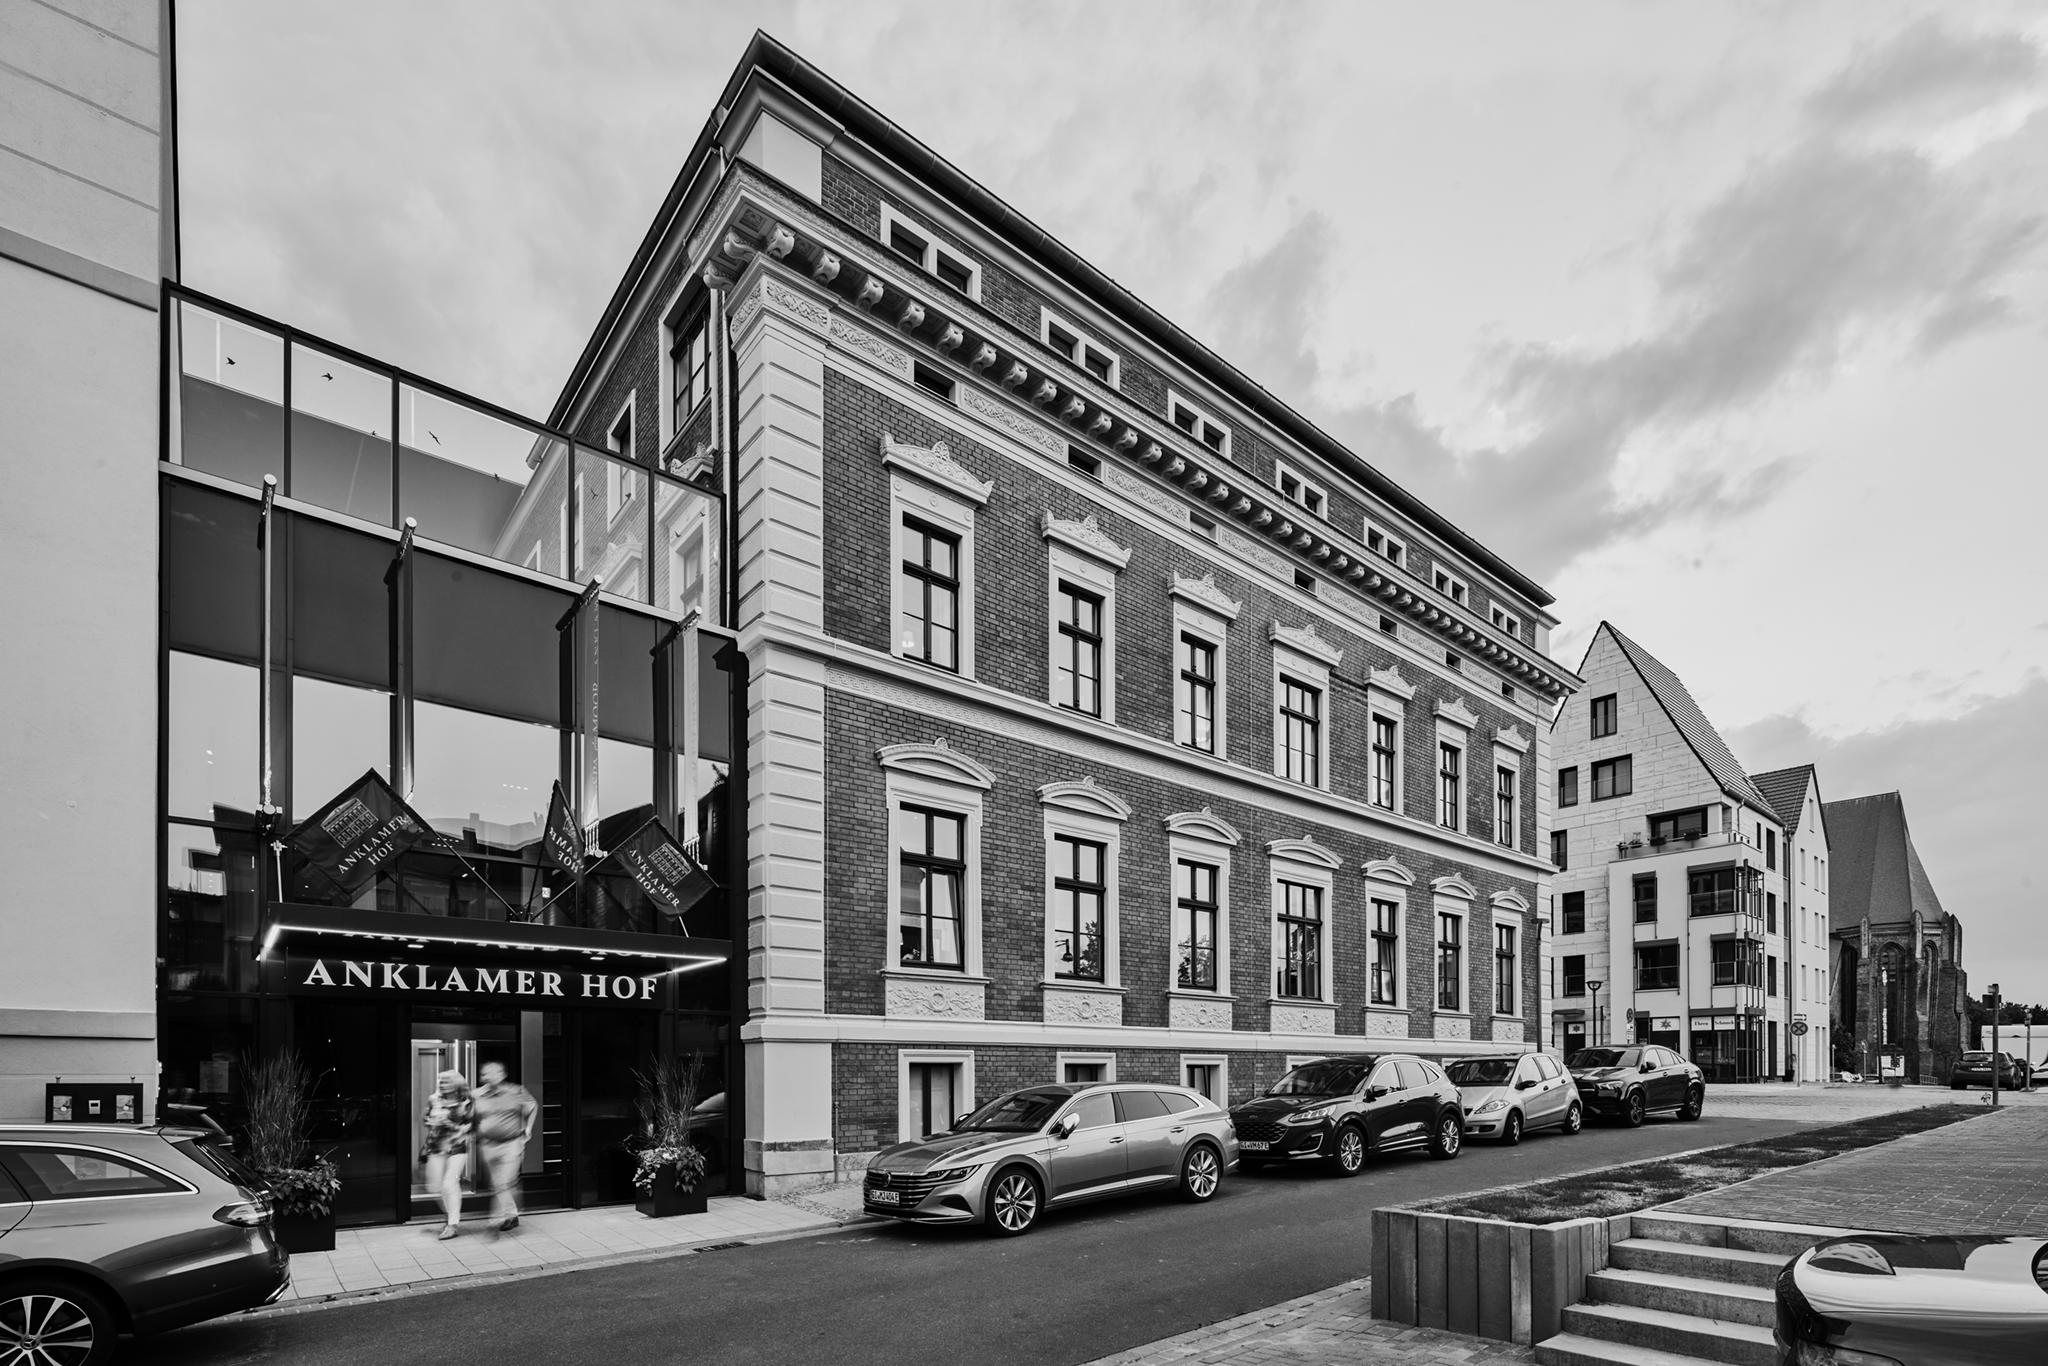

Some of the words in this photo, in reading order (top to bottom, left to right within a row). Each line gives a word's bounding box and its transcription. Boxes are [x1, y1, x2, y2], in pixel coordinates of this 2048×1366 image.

[337, 814, 410, 874] ANKLAMER
[367, 840, 395, 866] HOF
[629, 849, 681, 907] ANKLAMER
[635, 872, 658, 896] HOF
[302, 958, 565, 996] ANKLAMER
[580, 973, 658, 1000] HOF
